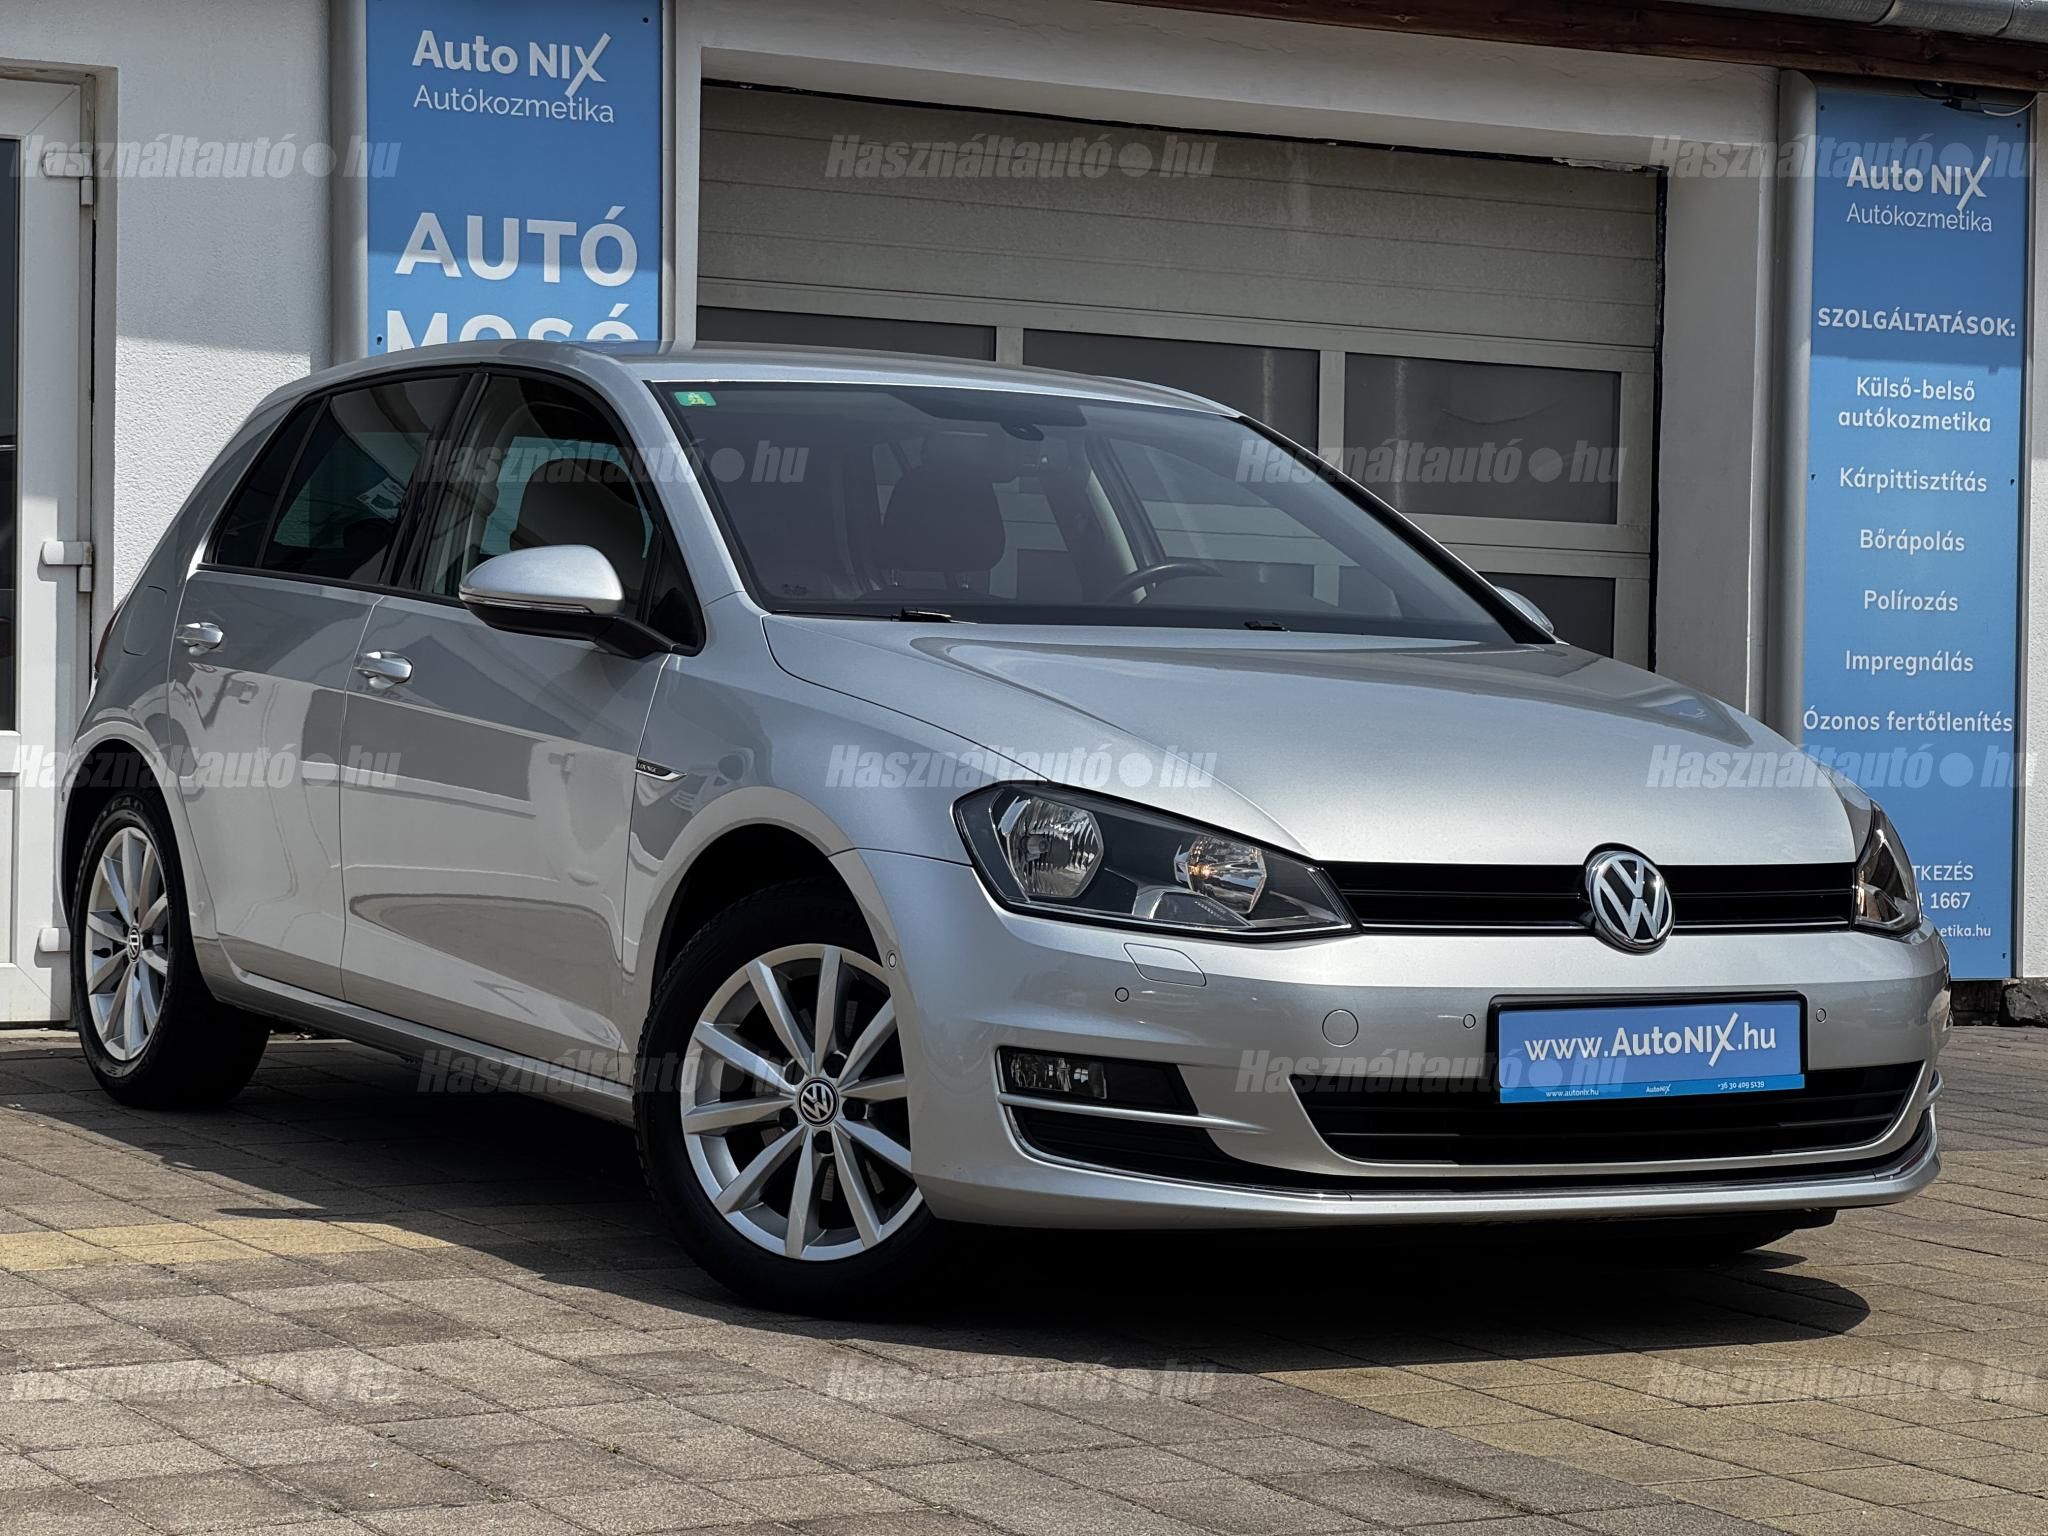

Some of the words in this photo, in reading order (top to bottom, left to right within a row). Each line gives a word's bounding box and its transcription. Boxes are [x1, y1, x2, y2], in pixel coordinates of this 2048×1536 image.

[411, 30, 518, 75] Auto
[529, 33, 611, 97] NIX
[413, 85, 615, 124] Autókozmetika
[1847, 156, 1924, 193] Auto
[1931, 156, 1991, 210] NIX
[1846, 203, 1993, 233] Autókozmetika
[395, 205, 639, 287] AUTÓ
[1817, 306, 2017, 338] SZOLGÁLTATÁSOK:
[1856, 376, 1976, 402] Külső-belső
[1838, 408, 1992, 433] autókozmetika
[1839, 466, 1988, 494] Kárpittisztítás
[1859, 528, 1966, 555] Bőrápolás
[1863, 589, 1959, 612] Polírozás
[1845, 649, 1974, 675] Impregnálás
[1803, 704, 1881, 732] Ózonos
[1886, 707, 2014, 733] fertőtlenítés
[1911, 860, 1974, 881] TKEZÉS
[1930, 892, 1971, 909] 1667
[1940, 924, 1992, 937] etika.hu
[1524, 1012, 1777, 1067] www.AutoNIX.hu
[1545, 1087, 1600, 1098] www.autonix.hu
